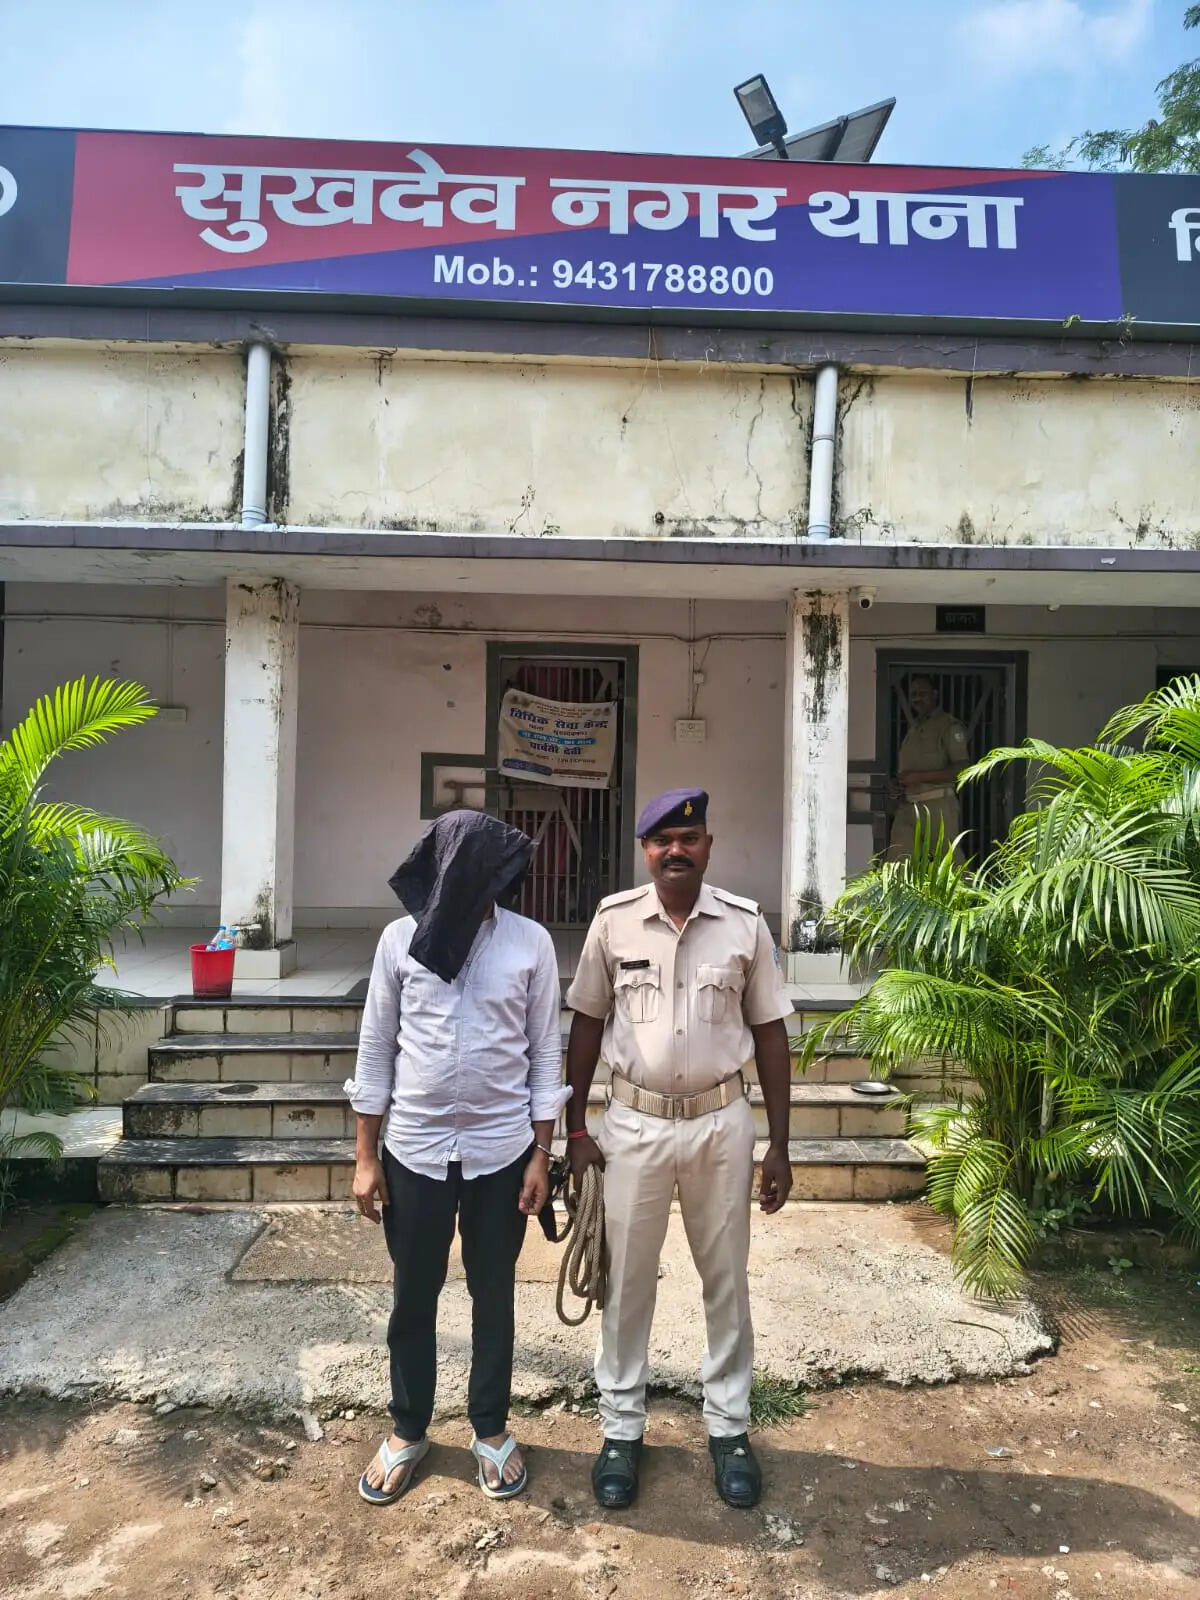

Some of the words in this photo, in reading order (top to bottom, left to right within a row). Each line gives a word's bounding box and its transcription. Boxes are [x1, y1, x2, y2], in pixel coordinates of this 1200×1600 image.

[173, 148, 526, 254] सुखदेव
[549, 177, 788, 242] नगर
[808, 190, 1024, 250] थाना
[433, 254, 538, 288] Mob.:
[552, 260, 775, 297] 9431788800
